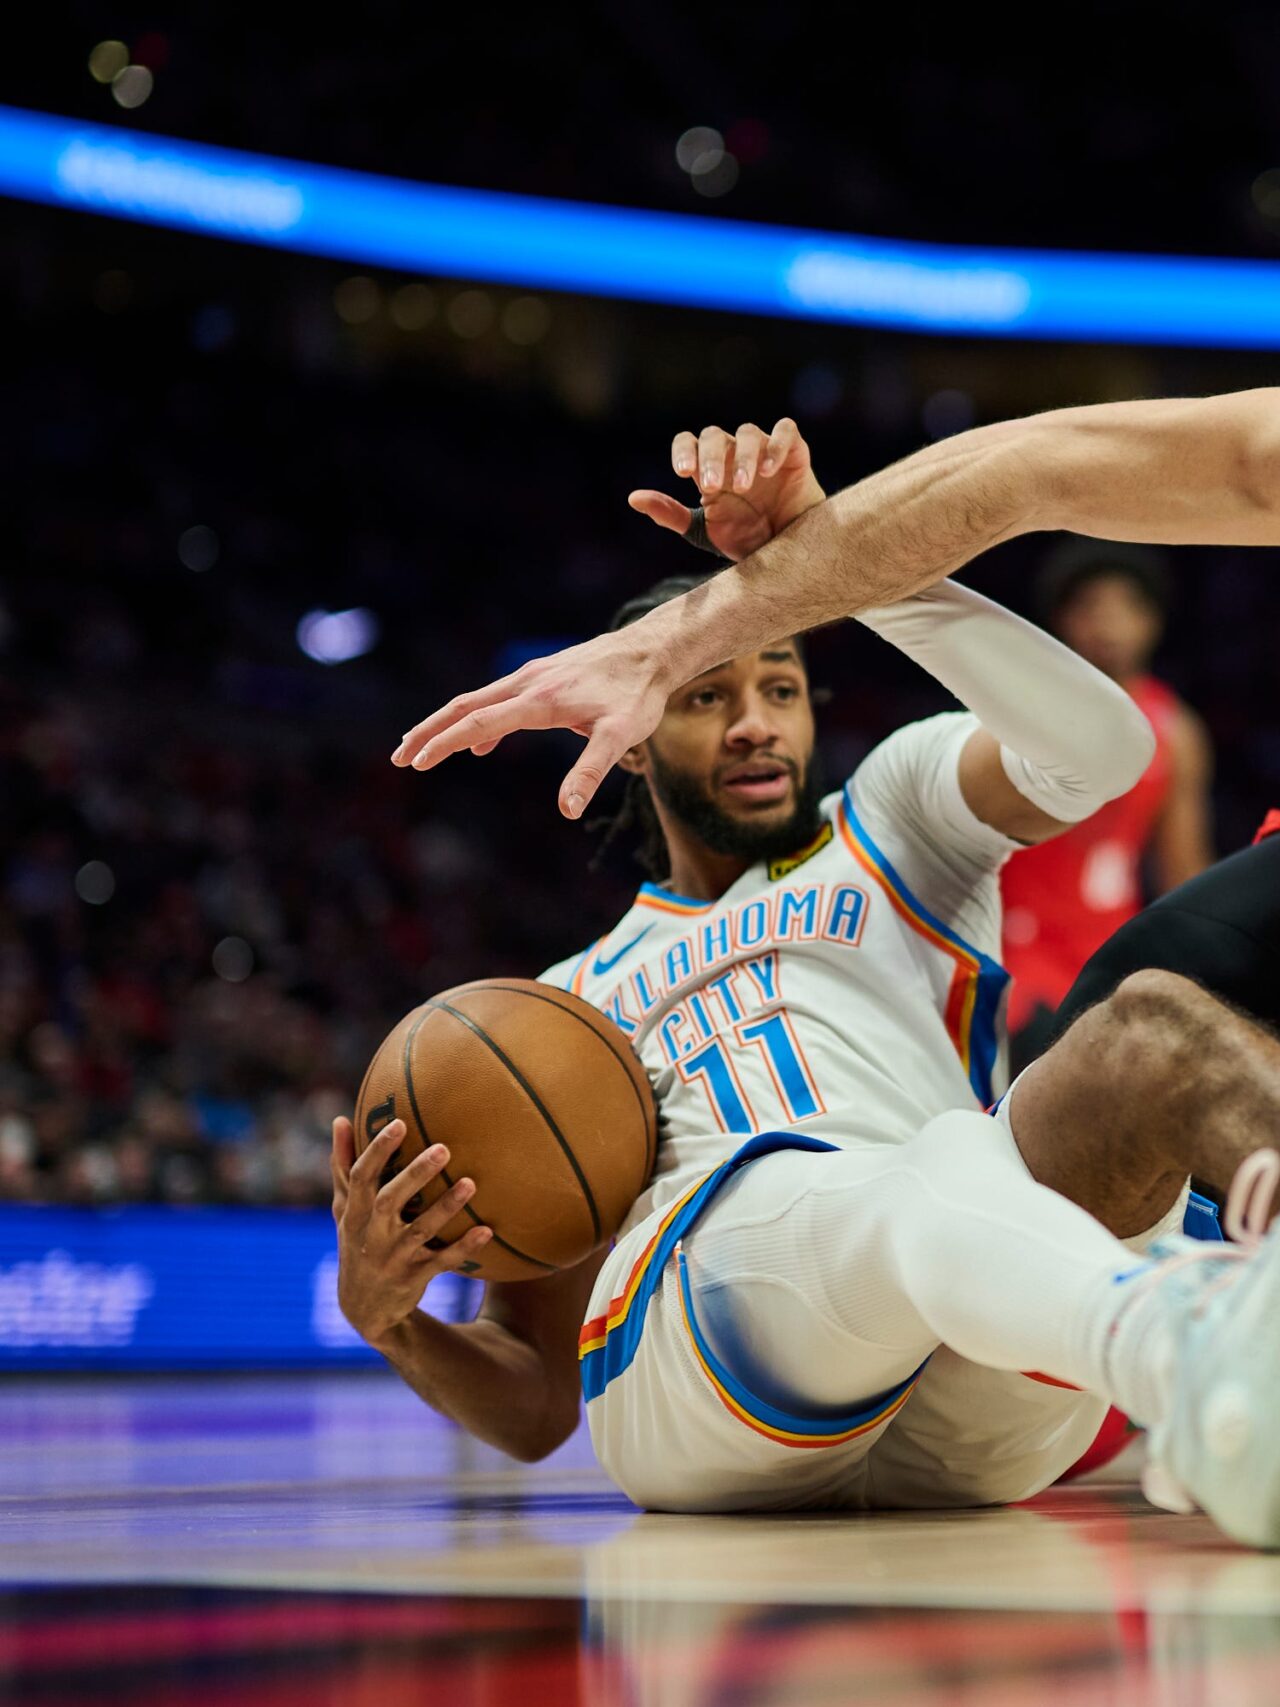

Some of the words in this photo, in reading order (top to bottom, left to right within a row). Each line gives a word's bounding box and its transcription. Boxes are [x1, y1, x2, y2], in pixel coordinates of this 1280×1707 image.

[602, 884, 869, 1040] KLAHOMA
[657, 950, 781, 1063] CITY
[675, 1008, 827, 1135] 11
